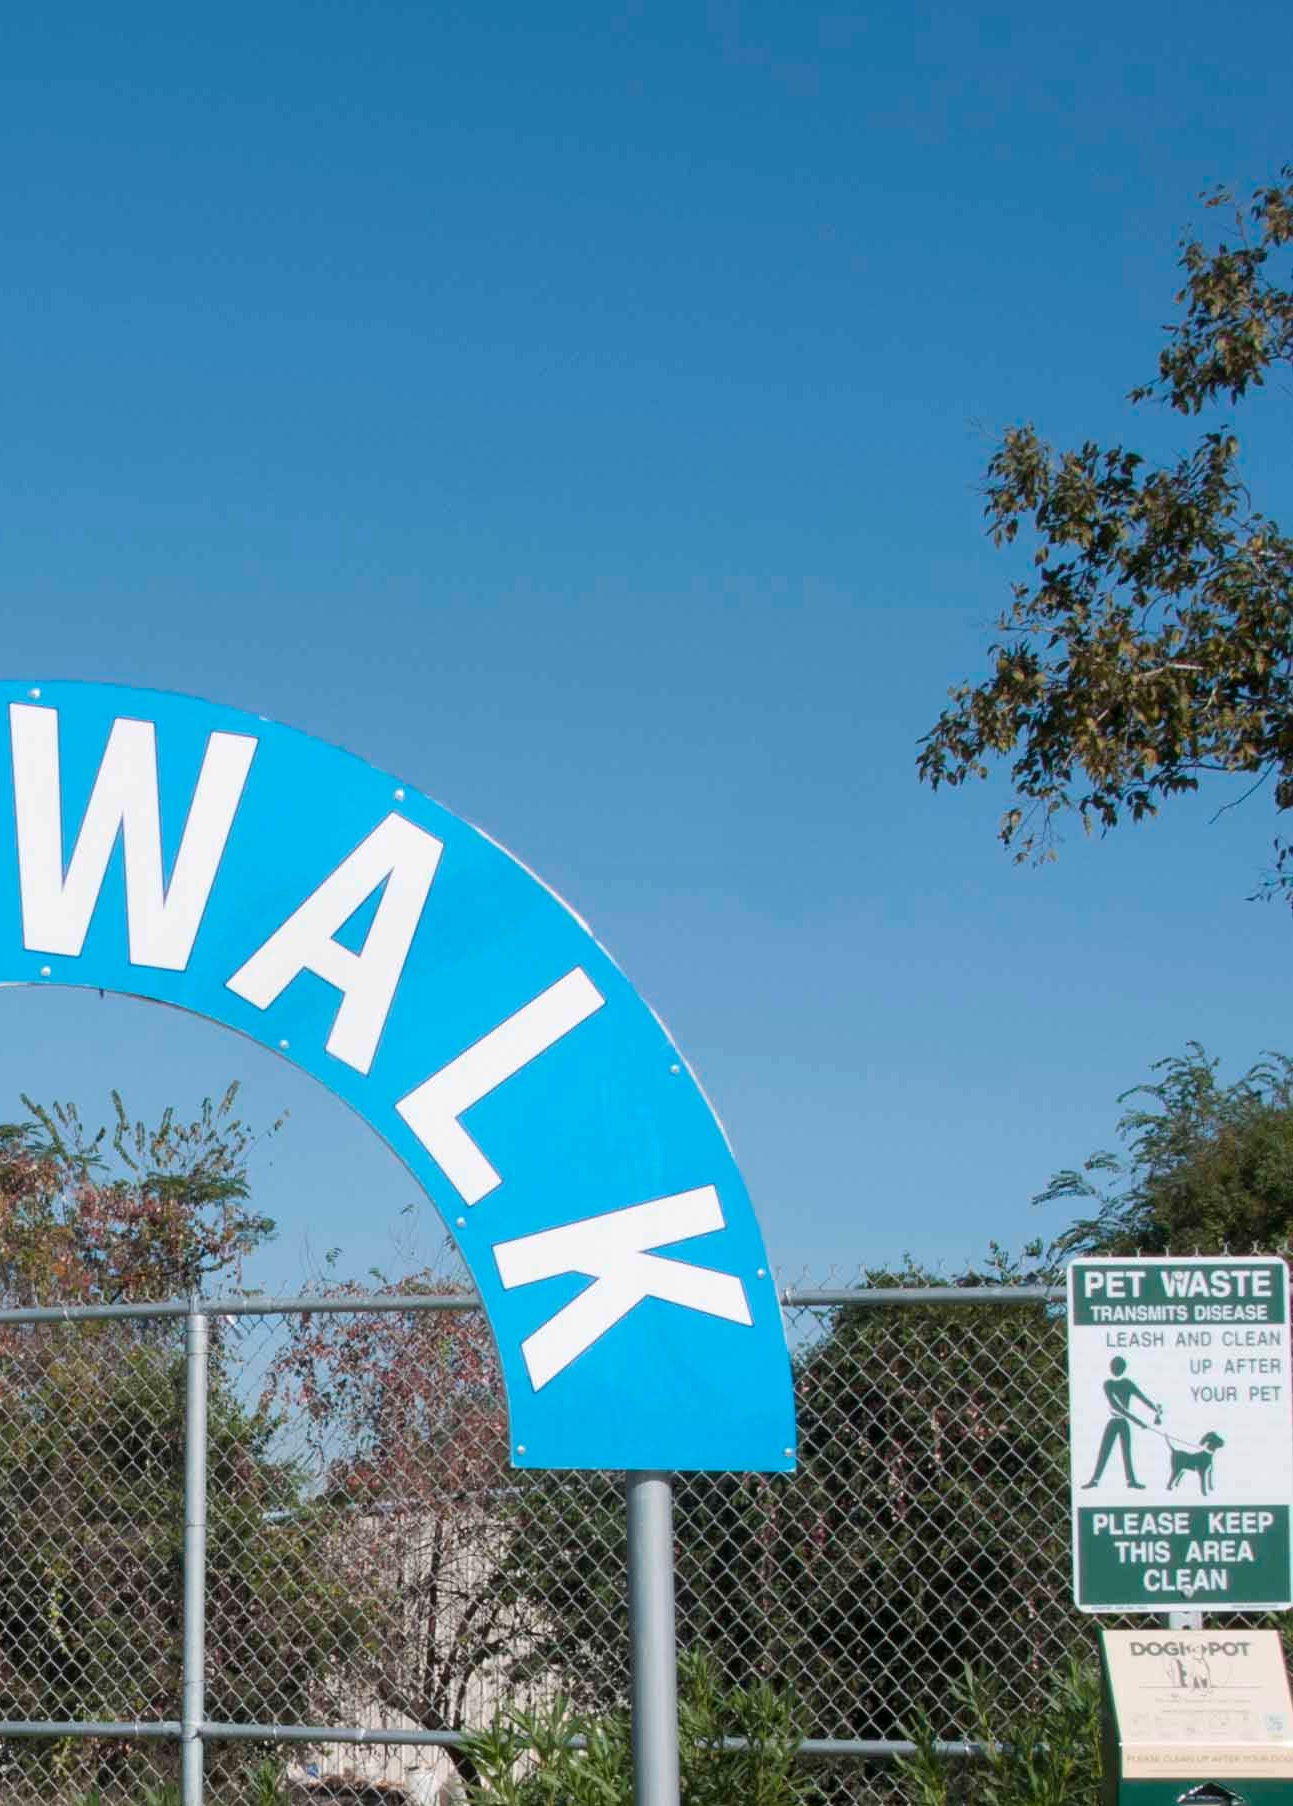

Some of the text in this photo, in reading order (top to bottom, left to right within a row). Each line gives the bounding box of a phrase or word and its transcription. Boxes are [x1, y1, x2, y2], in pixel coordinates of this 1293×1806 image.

[10, 704, 753, 1389] WALK
[1083, 1270, 1273, 1298] PET WASTE
[1091, 1304, 1268, 1321] TRANSMITS DISEASE
[1106, 1331, 1281, 1347] LEASH AND CLEAN
[1189, 1358, 1282, 1374] UP AFTER
[1190, 1386, 1282, 1402] YOUR PET
[1092, 1512, 1274, 1535] PLEASE KEEP
[1115, 1540, 1254, 1563] THIS AREA
[1143, 1568, 1228, 1591] CLEAN
